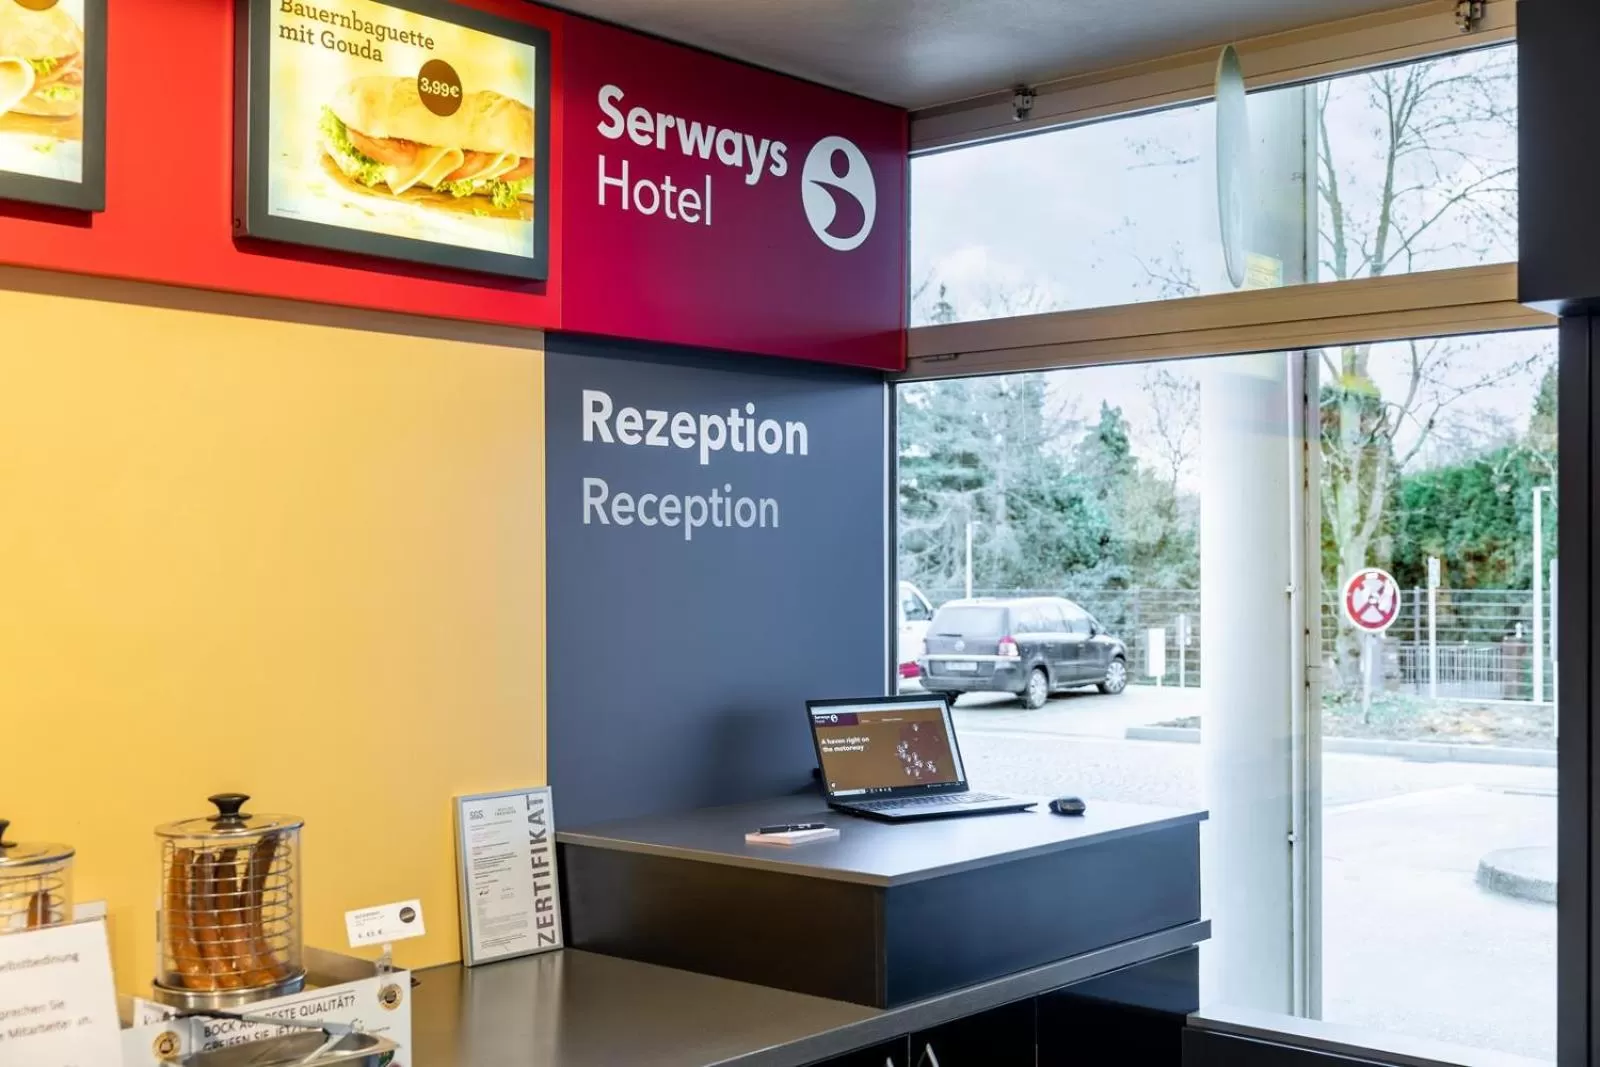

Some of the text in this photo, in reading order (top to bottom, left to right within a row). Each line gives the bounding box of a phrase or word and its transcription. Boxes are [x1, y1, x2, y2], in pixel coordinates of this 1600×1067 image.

[279, 0, 435, 50] Bauernbaguette
[279, 24, 384, 62] mit Gouda
[420, 76, 460, 98] 3,99€
[597, 84, 789, 186] Serways
[598, 154, 712, 226] Hotel
[582, 389, 809, 465] Rezeption
[583, 477, 780, 541] Reception
[846, 736, 861, 745] right
[525, 793, 556, 947] ZERTIFIKAT
[204, 1021, 235, 1038] BOCK
[300, 995, 356, 1016] QUALITÄT?
